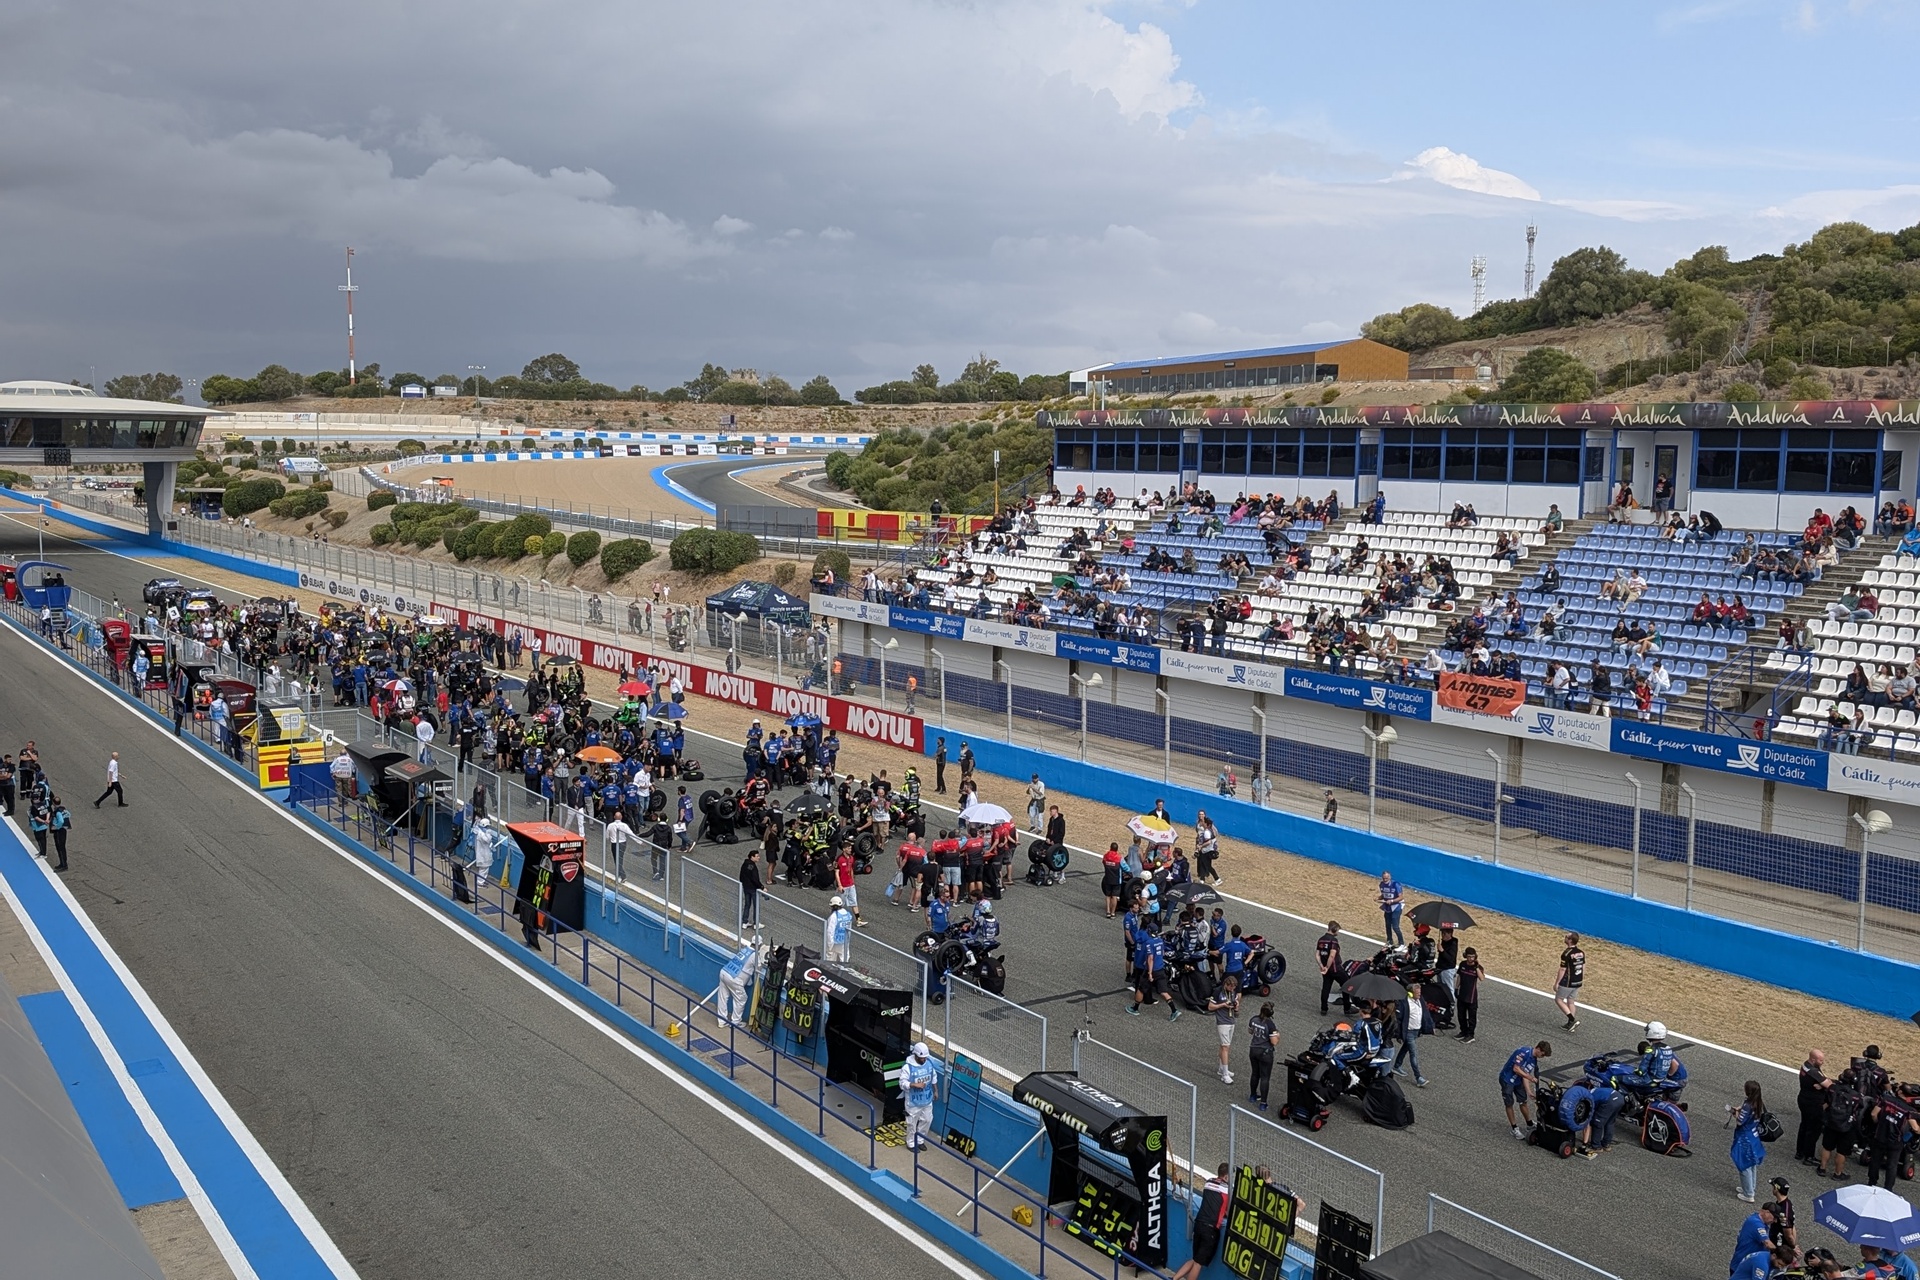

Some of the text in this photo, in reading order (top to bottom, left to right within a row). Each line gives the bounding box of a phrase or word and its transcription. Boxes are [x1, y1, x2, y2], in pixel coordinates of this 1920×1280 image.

[1168, 410, 1213, 427] Andalucía
[1241, 409, 1290, 426] Andalucía
[1316, 407, 1370, 426] Andalucía
[1402, 407, 1462, 426] Andalucía
[1499, 406, 1565, 426] Andalucía
[1611, 405, 1686, 426] Andalucía
[1726, 403, 1812, 427] Andalucía
[370, 593, 390, 606] SUBARU
[406, 602, 428, 615] SUBARU
[545, 633, 583, 661] MOTUL
[1060, 639, 1077, 650] Cádiz
[1095, 647, 1110, 656] verte
[1130, 647, 1155, 660] Diputación
[593, 644, 635, 675] MOTUL
[1129, 658, 1151, 669] de Cádiz
[1166, 657, 1185, 668] Cádiz
[1206, 664, 1224, 675] verte
[1248, 667, 1278, 682] Diputación
[1248, 678, 1272, 689] de Cádiz
[705, 671, 758, 706] MOTUL
[1291, 676, 1313, 689] Cádiz
[1339, 686, 1361, 697] verte
[1388, 689, 1424, 703] Diputación
[1465, 695, 1490, 711] 47
[771, 687, 830, 725] MOTUL
[1388, 702, 1417, 715] de Cádiz
[846, 705, 915, 748] MOTUL
[1558, 715, 1601, 731] Diputación
[326, 733, 333, 742] 6
[1557, 730, 1592, 743] de Cádiz
[1620, 729, 1652, 745] Cádiz
[1692, 743, 1722, 757] verte
[1763, 748, 1816, 767] Diputación
[1763, 764, 1805, 780] de Cádiz
[1841, 765, 1880, 783] Cádiz
[818, 975, 848, 994] CLEANER
[1066, 1078, 1124, 1108] ALTHEA
[1022, 1092, 1053, 1115] MOTO
[1148, 1161, 1161, 1249] ALTHEA
[1830, 1218, 1849, 1232] YAMAHA
